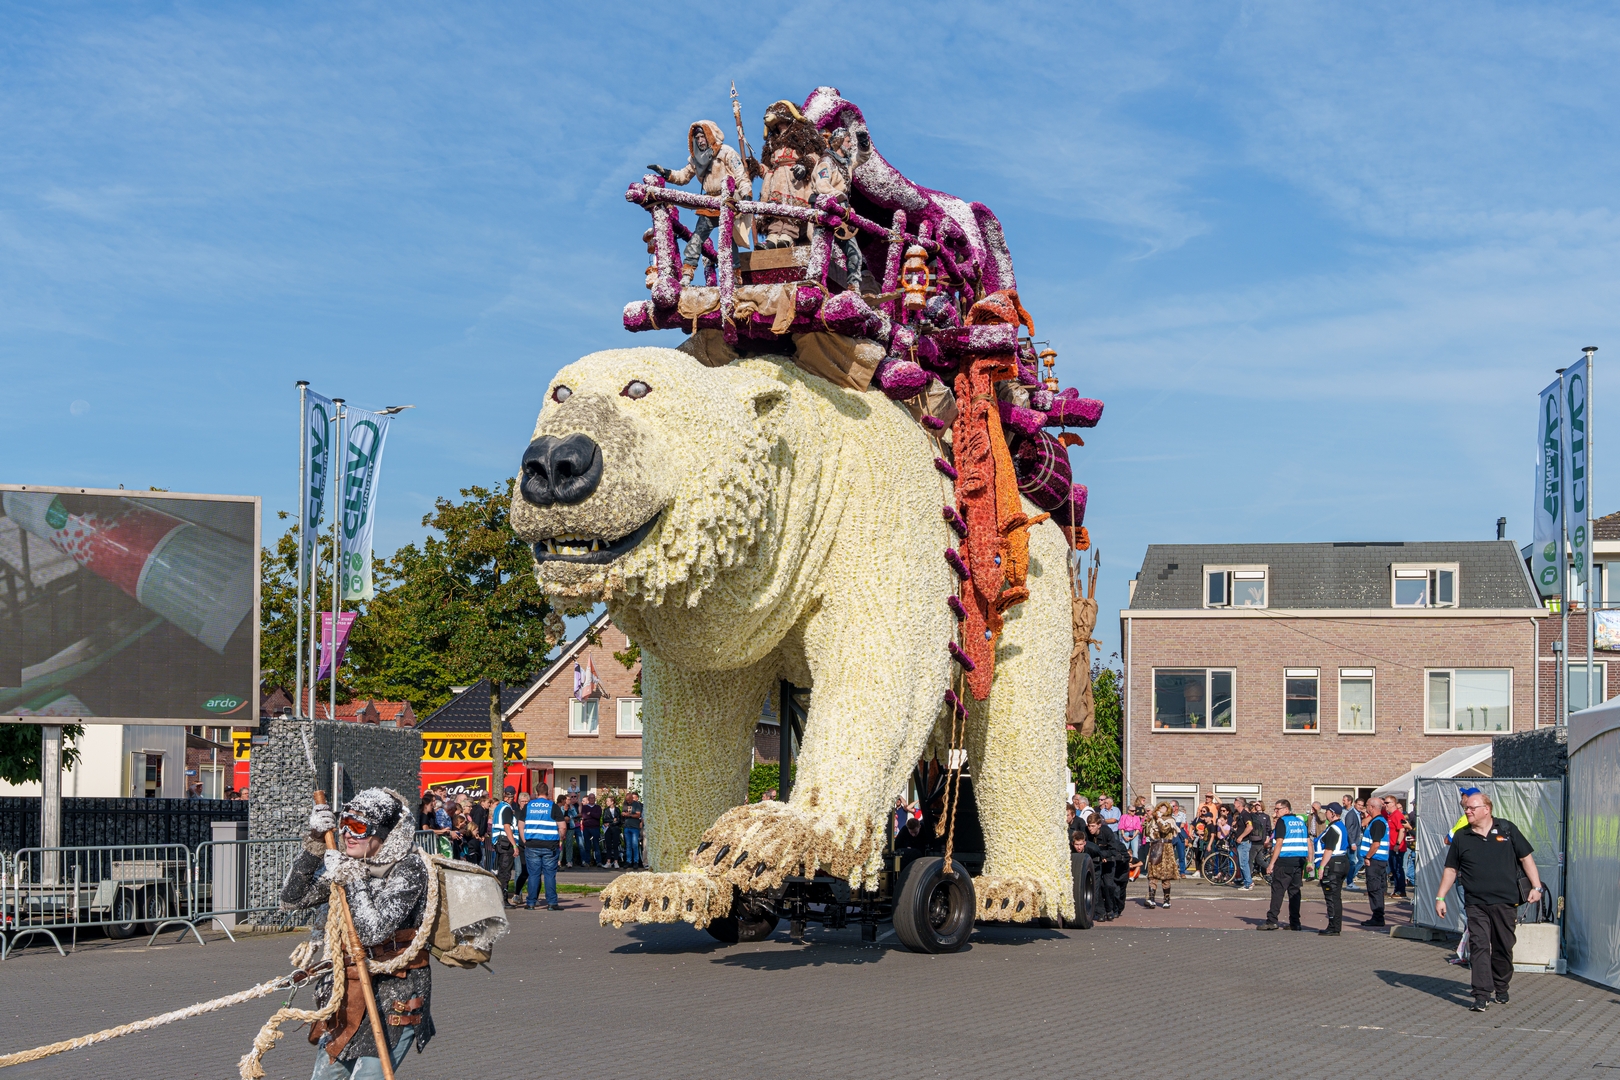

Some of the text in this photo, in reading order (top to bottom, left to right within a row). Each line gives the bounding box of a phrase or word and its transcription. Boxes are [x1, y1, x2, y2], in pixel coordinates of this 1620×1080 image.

[343, 441, 369, 540] CLTV
[361, 460, 374, 514] ZUNDERT
[206, 698, 237, 708] ardo
[446, 785, 484, 798] cCain
